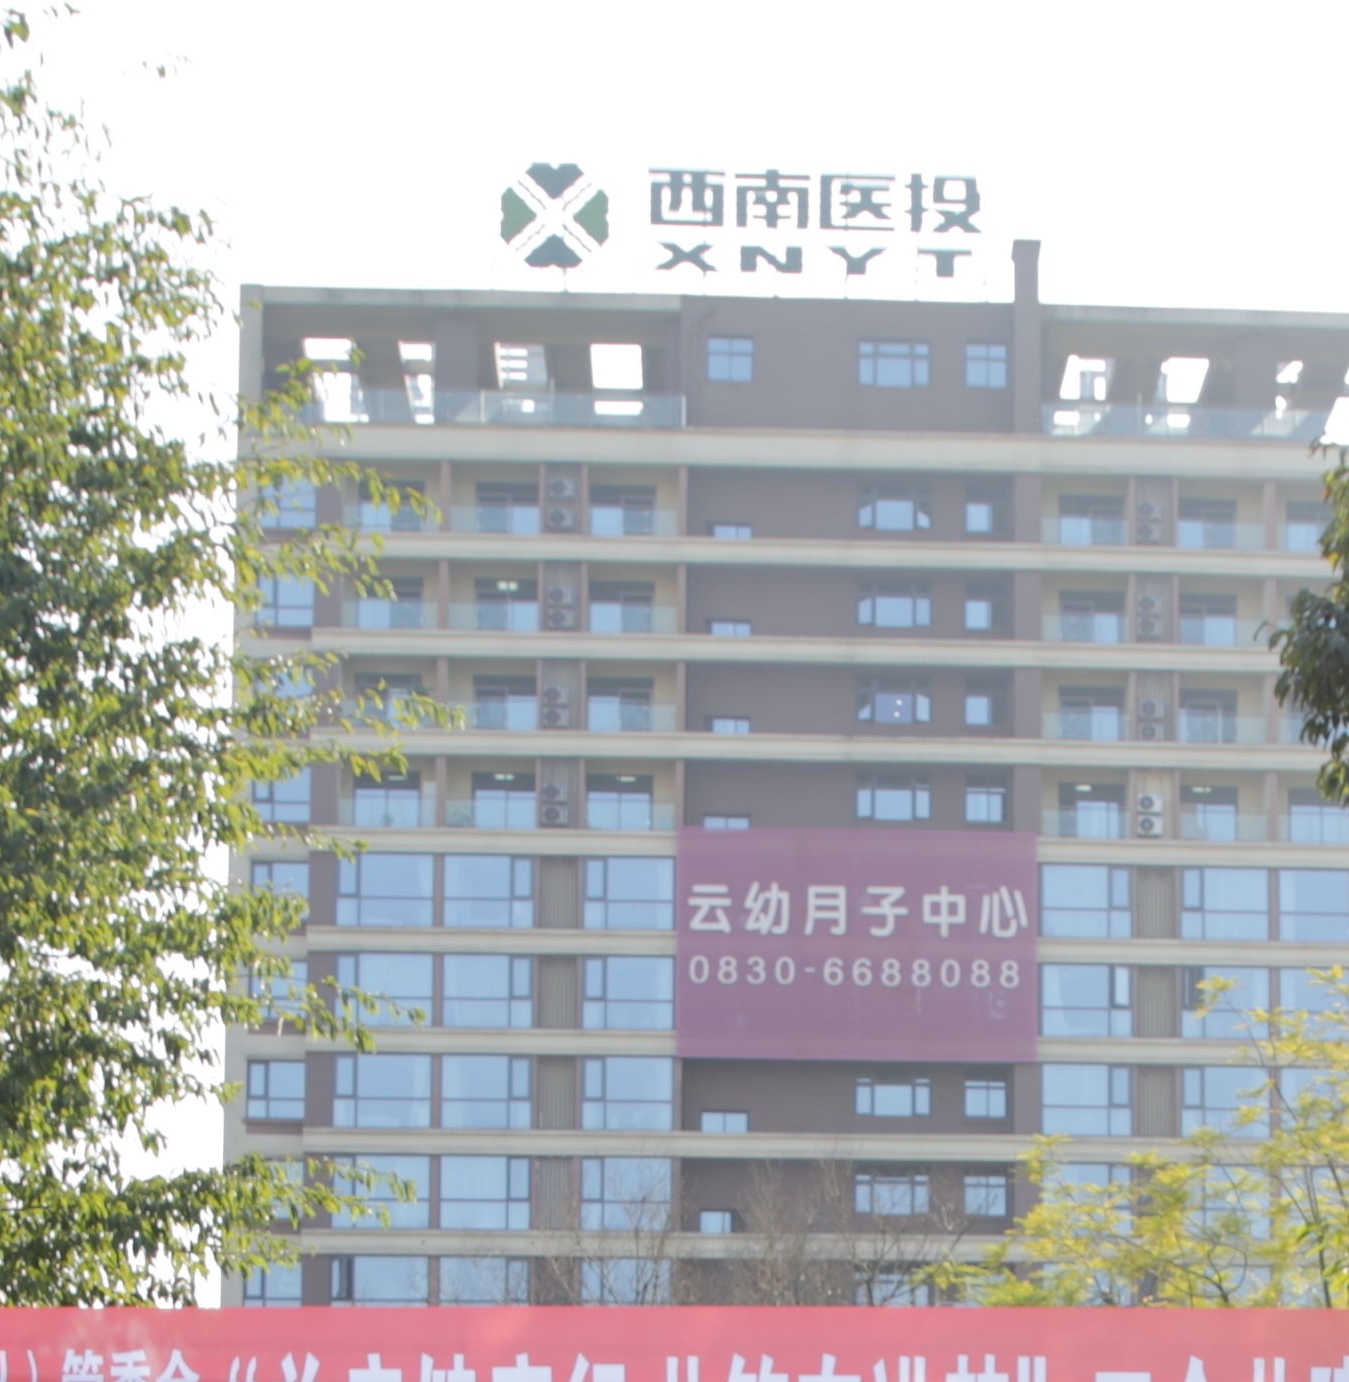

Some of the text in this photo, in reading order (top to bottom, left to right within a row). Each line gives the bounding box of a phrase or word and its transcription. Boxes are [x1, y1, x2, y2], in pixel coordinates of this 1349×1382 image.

[649, 168, 981, 233] 西南医投
[656, 242, 972, 278] XNYT
[688, 882, 1029, 938] 云幼月子中心
[688, 954, 1021, 989] 0830-6688088
